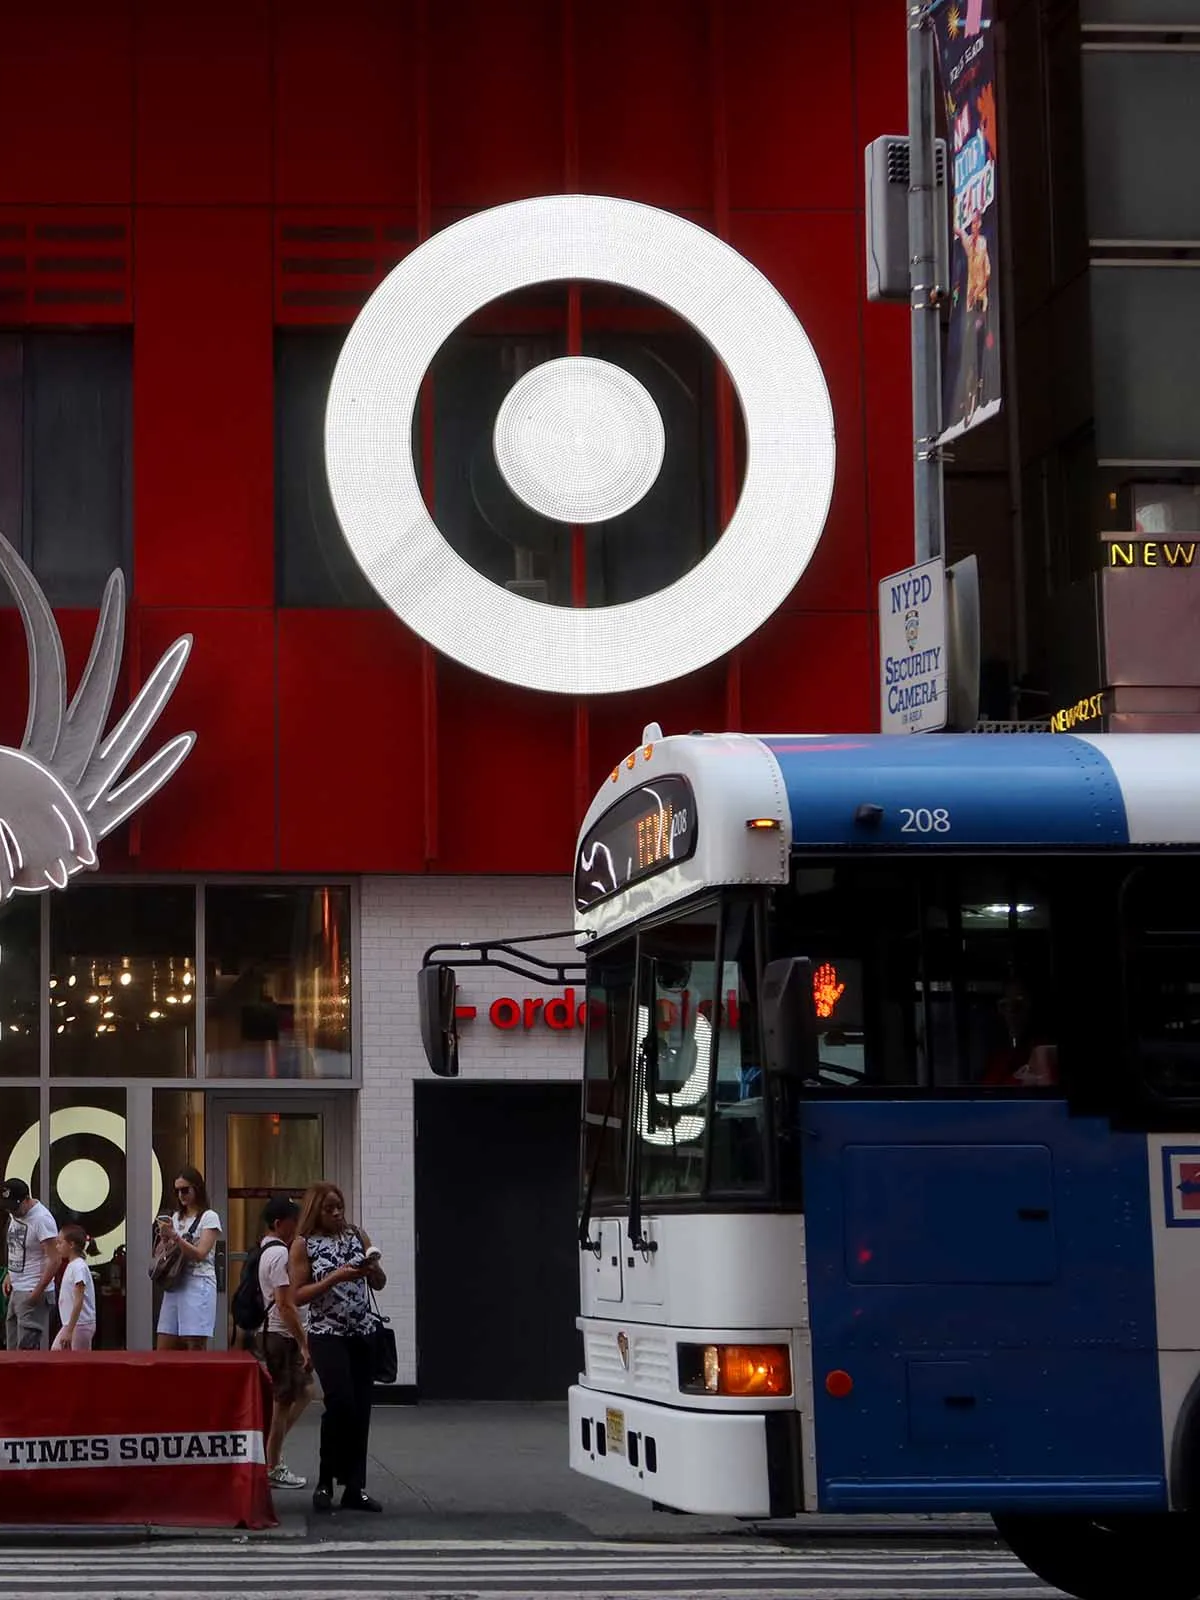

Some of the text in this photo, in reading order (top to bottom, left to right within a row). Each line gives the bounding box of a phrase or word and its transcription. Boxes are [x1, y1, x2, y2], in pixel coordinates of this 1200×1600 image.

[1111, 543, 1196, 566] NEW
[891, 574, 932, 614] NYPD
[886, 647, 941, 685] SECURITY
[888, 679, 937, 715] CAMERA
[899, 808, 951, 832] 208
[4, 1434, 248, 1464] TIMES SQUARE
